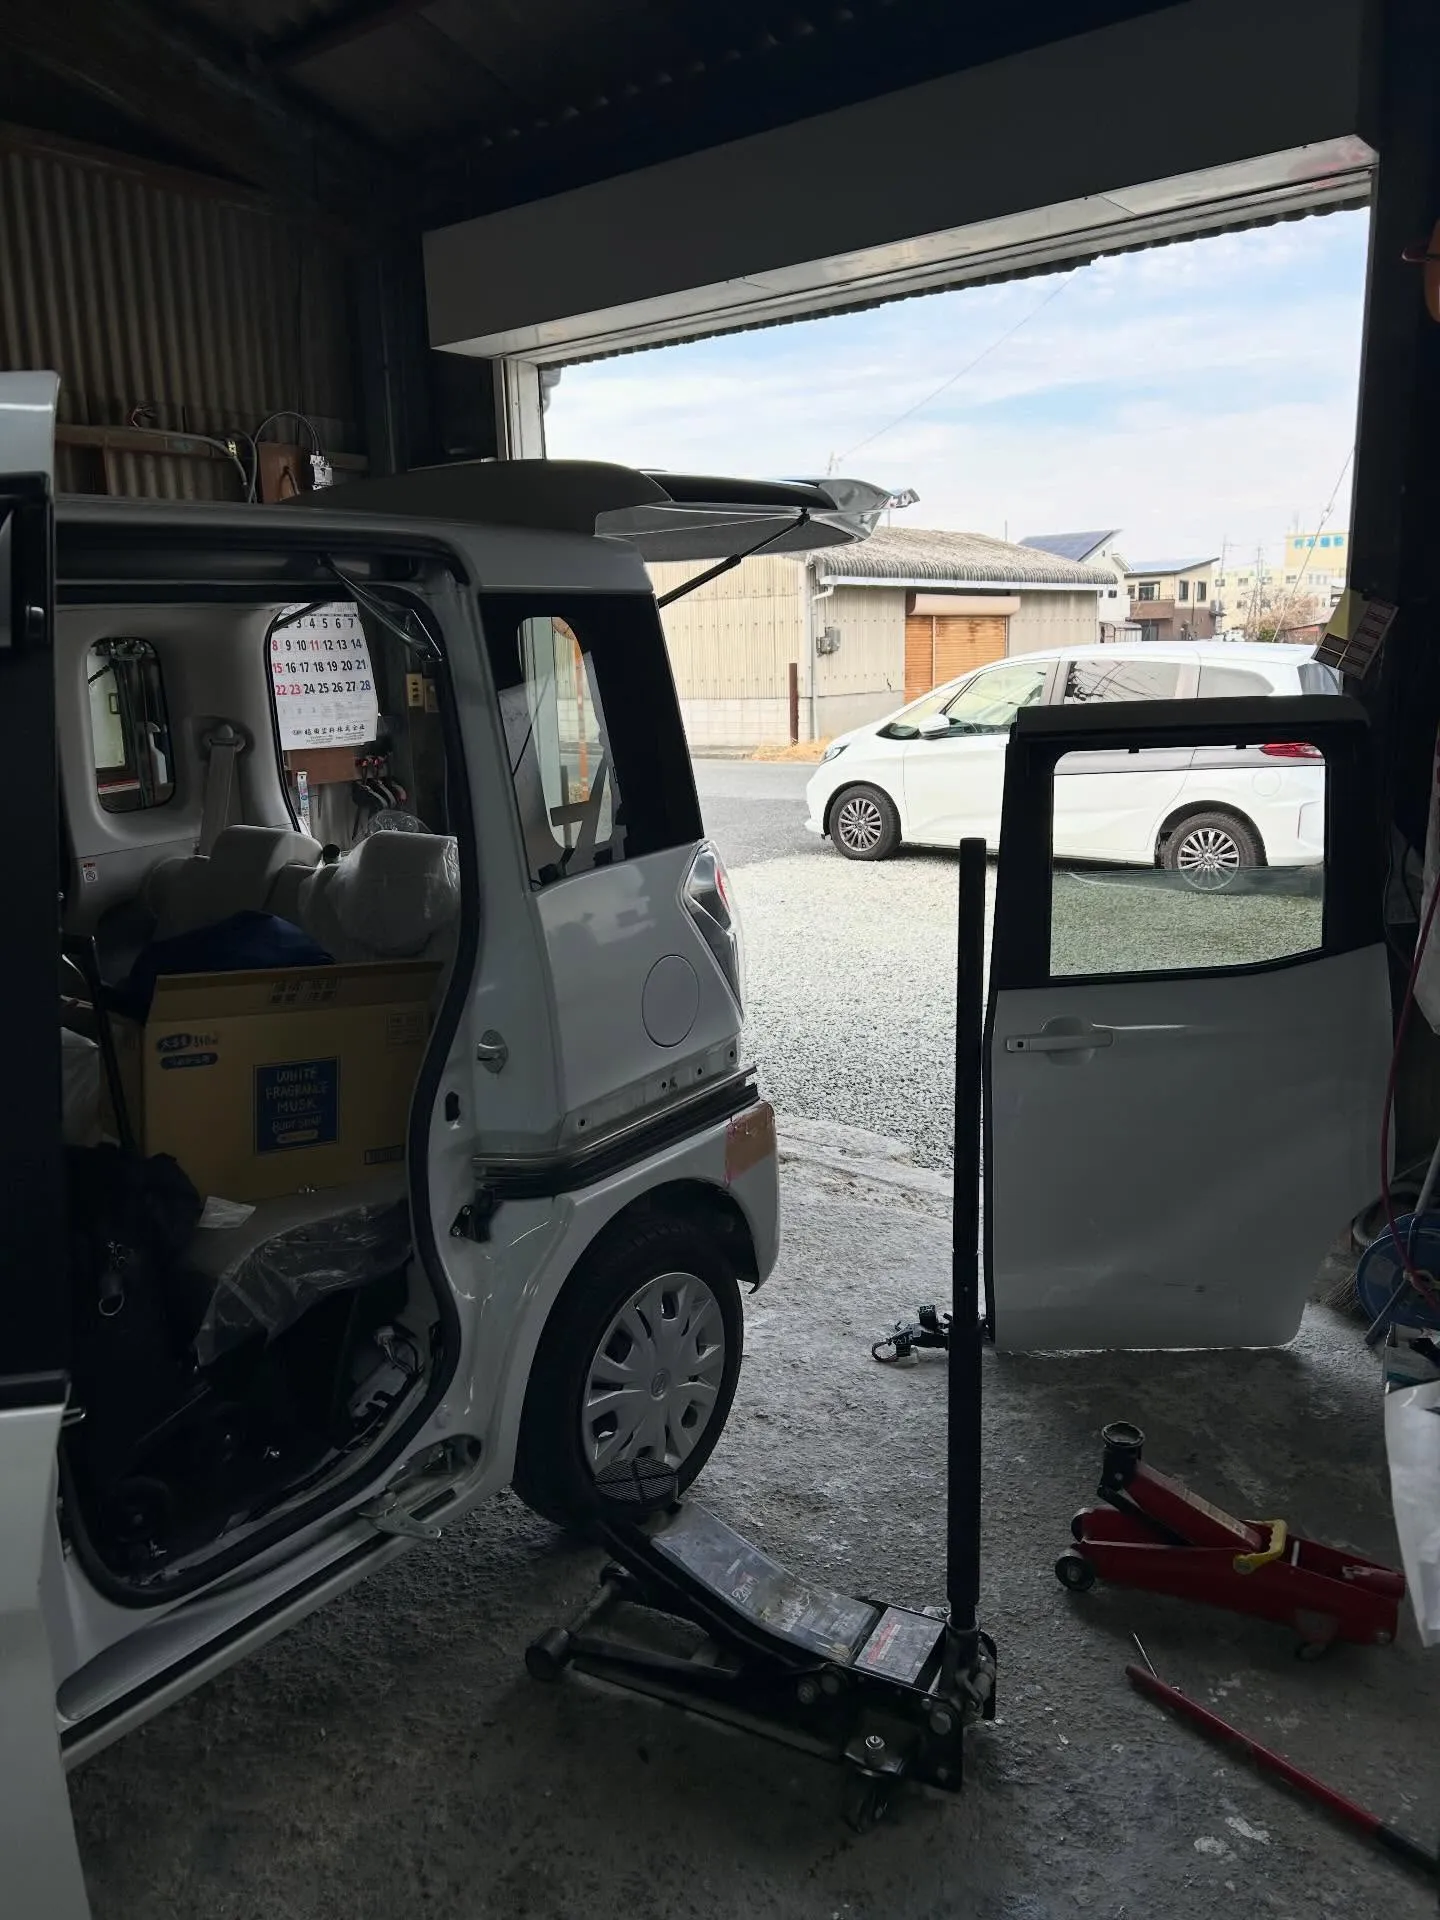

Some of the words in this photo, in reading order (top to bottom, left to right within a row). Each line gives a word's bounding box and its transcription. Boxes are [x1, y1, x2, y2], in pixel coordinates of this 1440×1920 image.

[297, 618, 302, 628] 3
[310, 618, 315, 628] 4
[322, 618, 328, 628] 5
[335, 618, 341, 628] 6
[348, 618, 354, 628] 7
[272, 641, 279, 651] 8
[286, 640, 291, 651] 9
[296, 640, 306, 650] 10
[310, 640, 320, 650] 11
[323, 640, 333, 650] 12
[337, 639, 347, 650] 13
[351, 638, 362, 649] 14
[273, 663, 283, 673] 15
[286, 663, 296, 673] 16
[300, 662, 309, 673] 17
[314, 662, 324, 672] 18
[328, 661, 338, 671] 19
[341, 660, 352, 671] 20
[356, 659, 366, 670] 21
[276, 685, 287, 695] 22
[290, 684, 301, 695] 23
[304, 684, 315, 694] 24
[318, 683, 329, 693] 25
[332, 682, 343, 693] 26
[346, 681, 356, 692] 27
[360, 680, 371, 690] 28
[277, 1098, 318, 1113] MUSK
